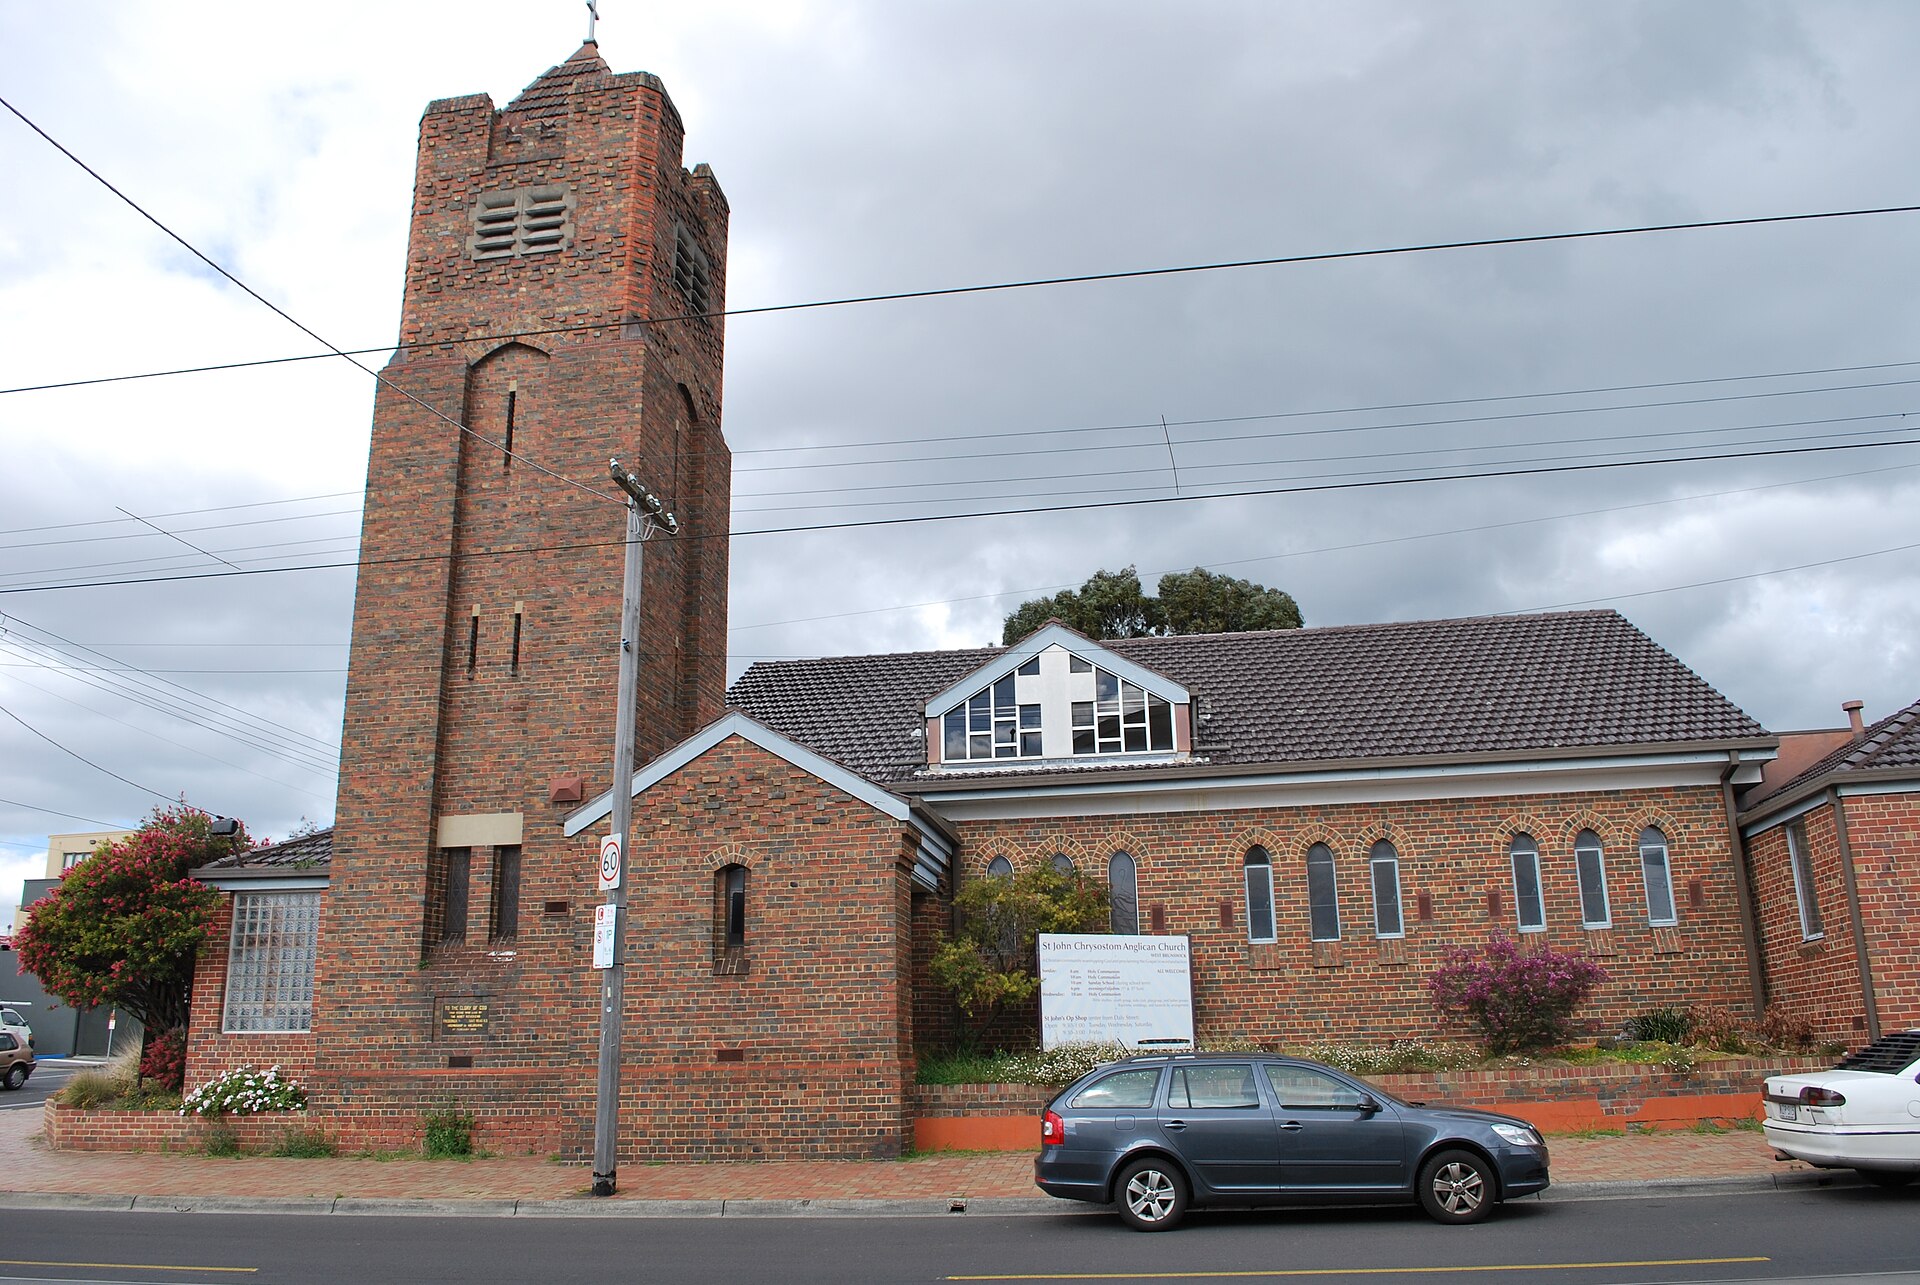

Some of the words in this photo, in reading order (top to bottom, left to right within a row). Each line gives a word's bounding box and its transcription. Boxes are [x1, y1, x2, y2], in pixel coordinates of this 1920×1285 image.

[603, 851, 617, 872] 60
[1042, 942, 1050, 950] St
[1053, 942, 1072, 951] John
[1074, 942, 1122, 952] Chrysostom
[1122, 942, 1156, 952] Anglican
[1158, 942, 1186, 951] Church
